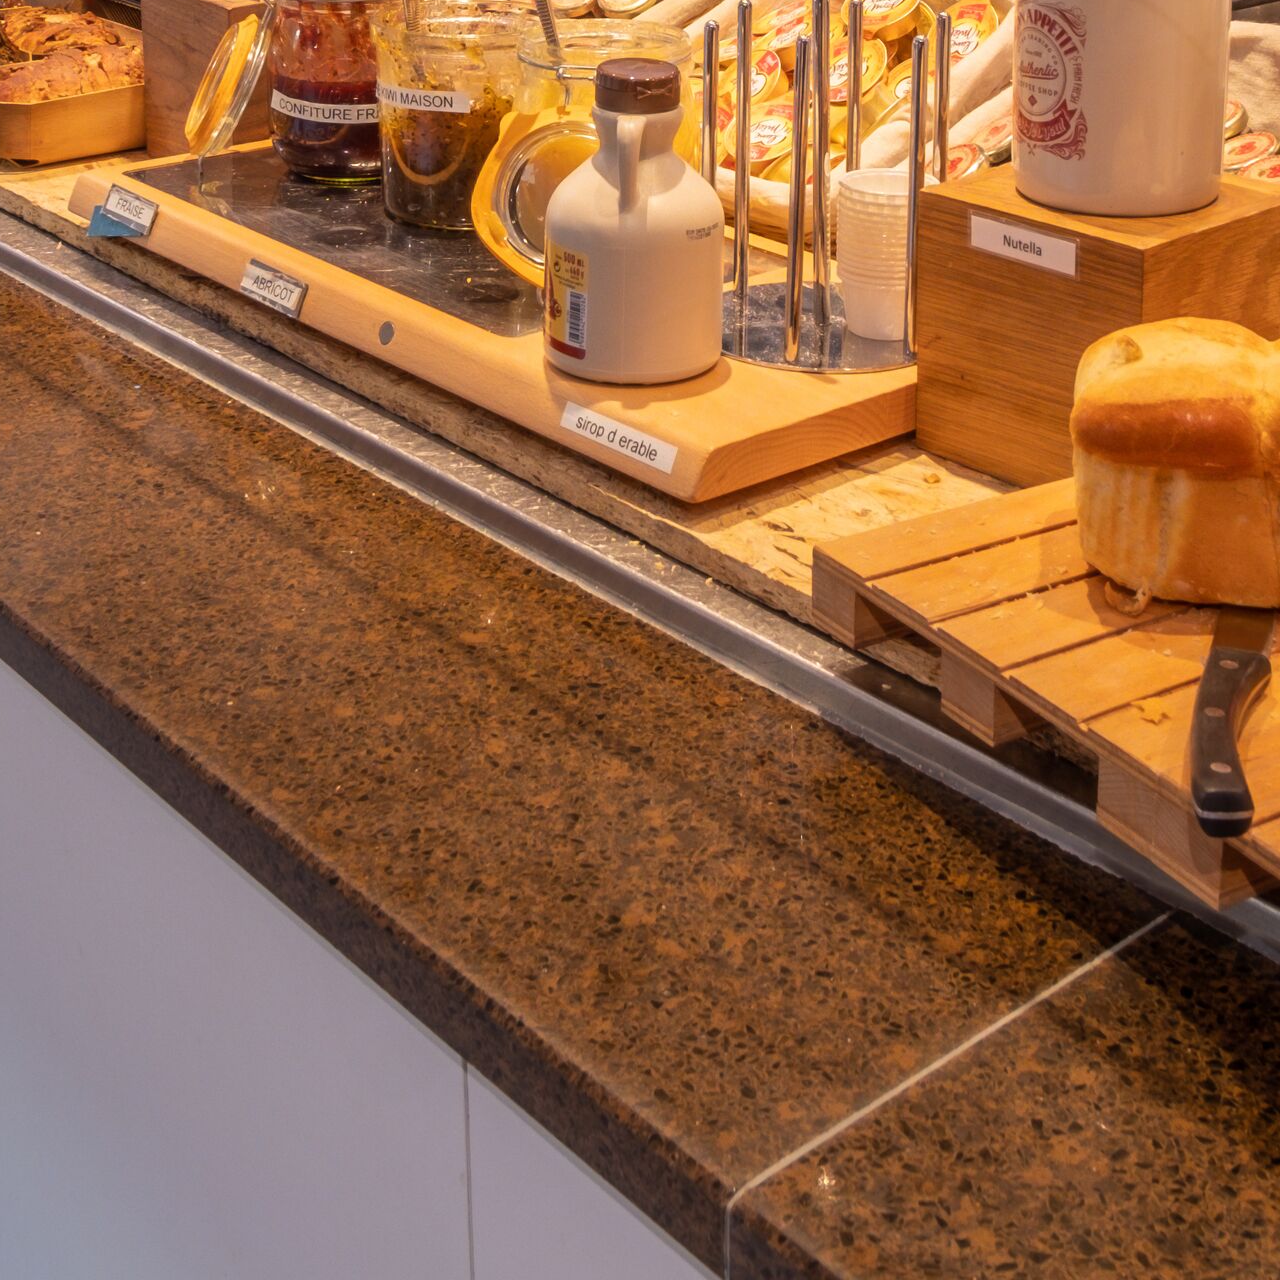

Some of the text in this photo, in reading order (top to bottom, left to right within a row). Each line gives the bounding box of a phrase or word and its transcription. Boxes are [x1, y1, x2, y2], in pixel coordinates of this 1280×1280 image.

[279, 98, 353, 121] CONFITURE
[400, 93, 454, 108] MAISON
[116, 197, 145, 220] FRAISE
[1003, 234, 1042, 257] Nutella
[251, 275, 295, 303] ABRICOT
[575, 416, 658, 462] sirop d erable
